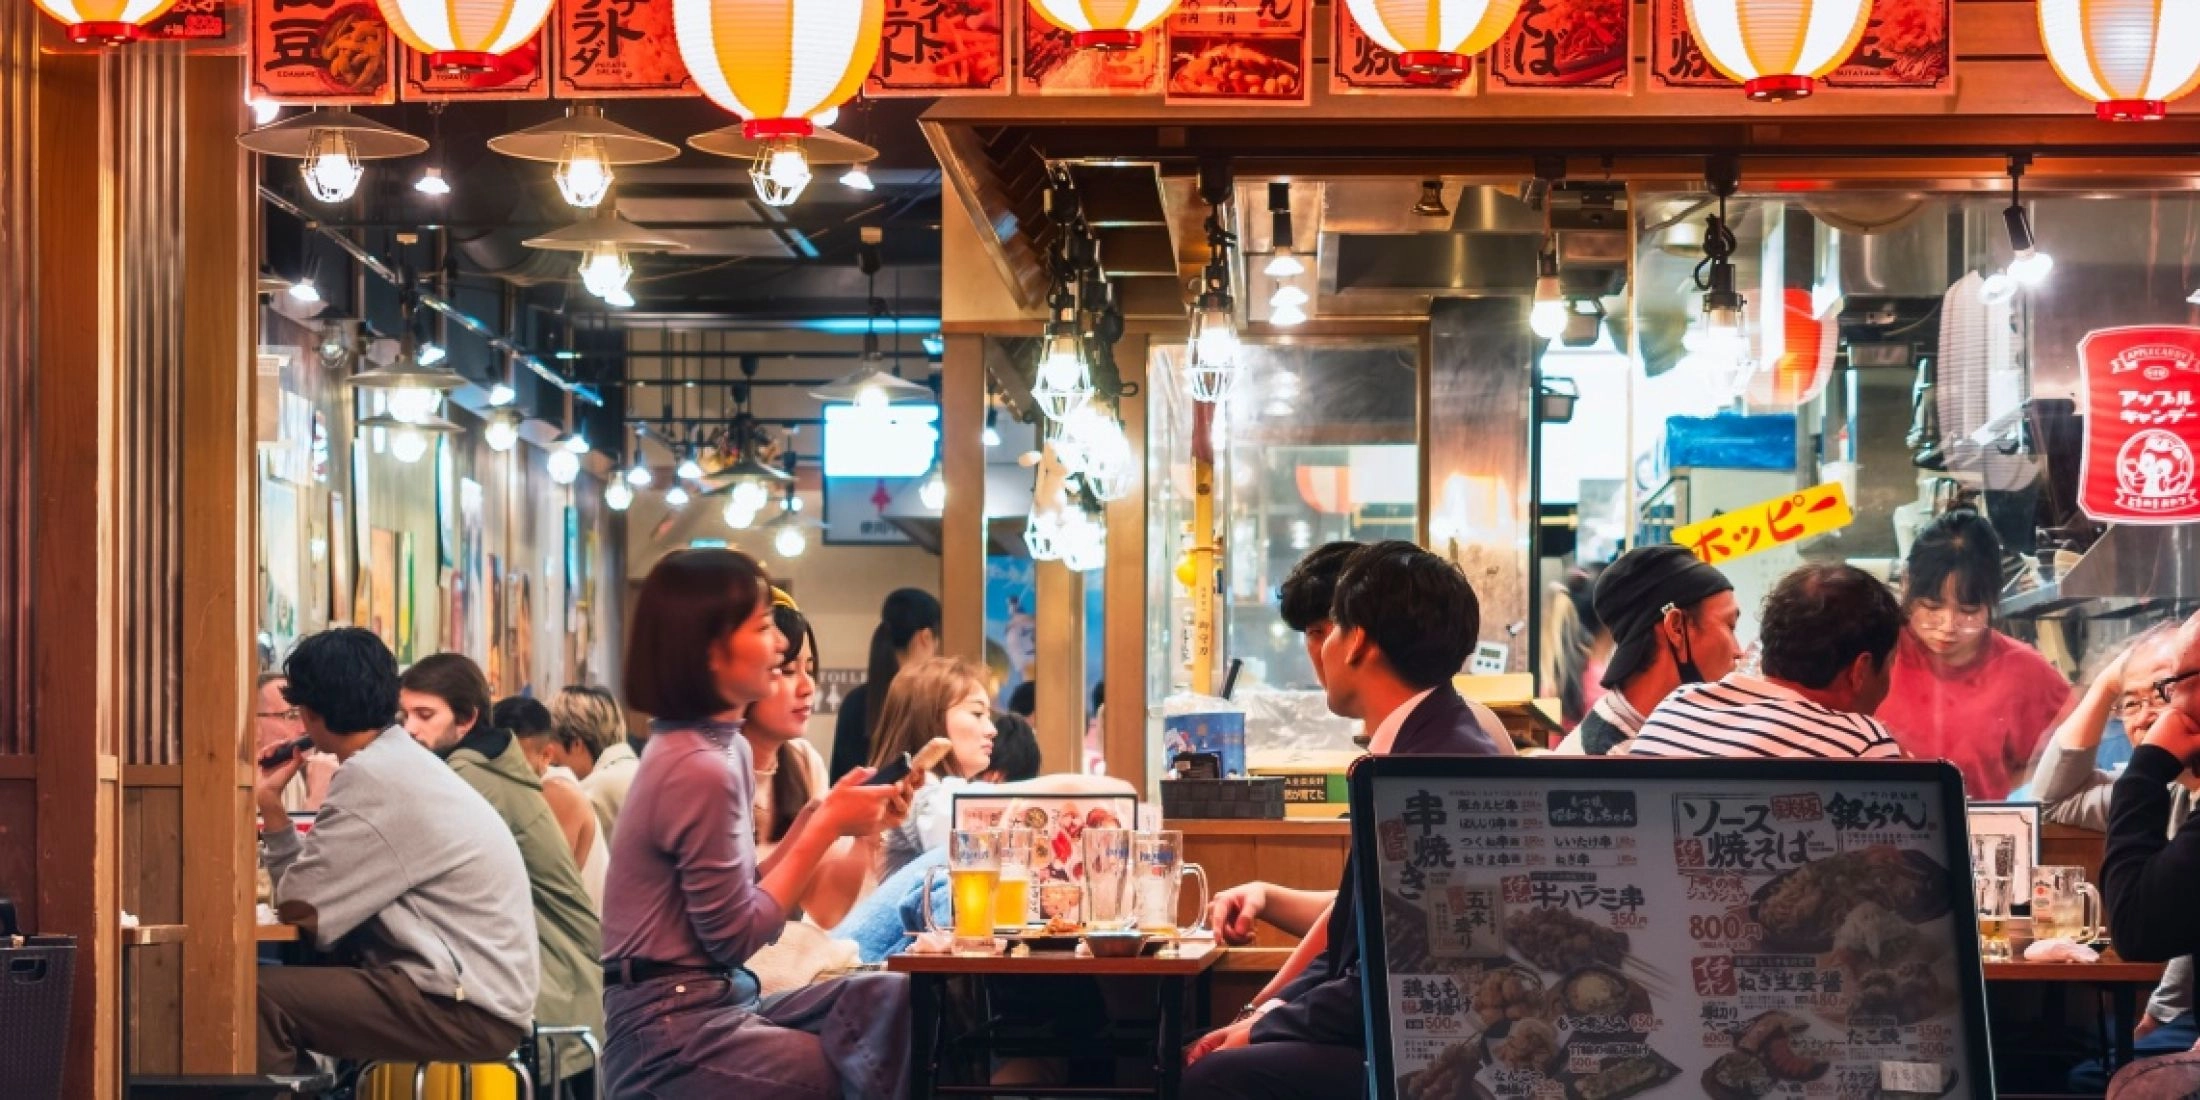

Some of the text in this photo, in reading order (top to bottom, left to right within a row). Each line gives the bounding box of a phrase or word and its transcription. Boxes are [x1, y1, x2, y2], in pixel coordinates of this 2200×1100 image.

[264, 0, 334, 71] 豆
[570, 0, 605, 75] ラダ
[882, 0, 914, 77] テト
[917, 0, 946, 64] イド
[2119, 390, 2194, 407] アップル
[1692, 494, 1837, 564] ホッピー
[1683, 799, 1776, 836] ソース
[1708, 830, 1814, 871] 焼そば
[1532, 881, 1645, 912] 牛ハラミ串
